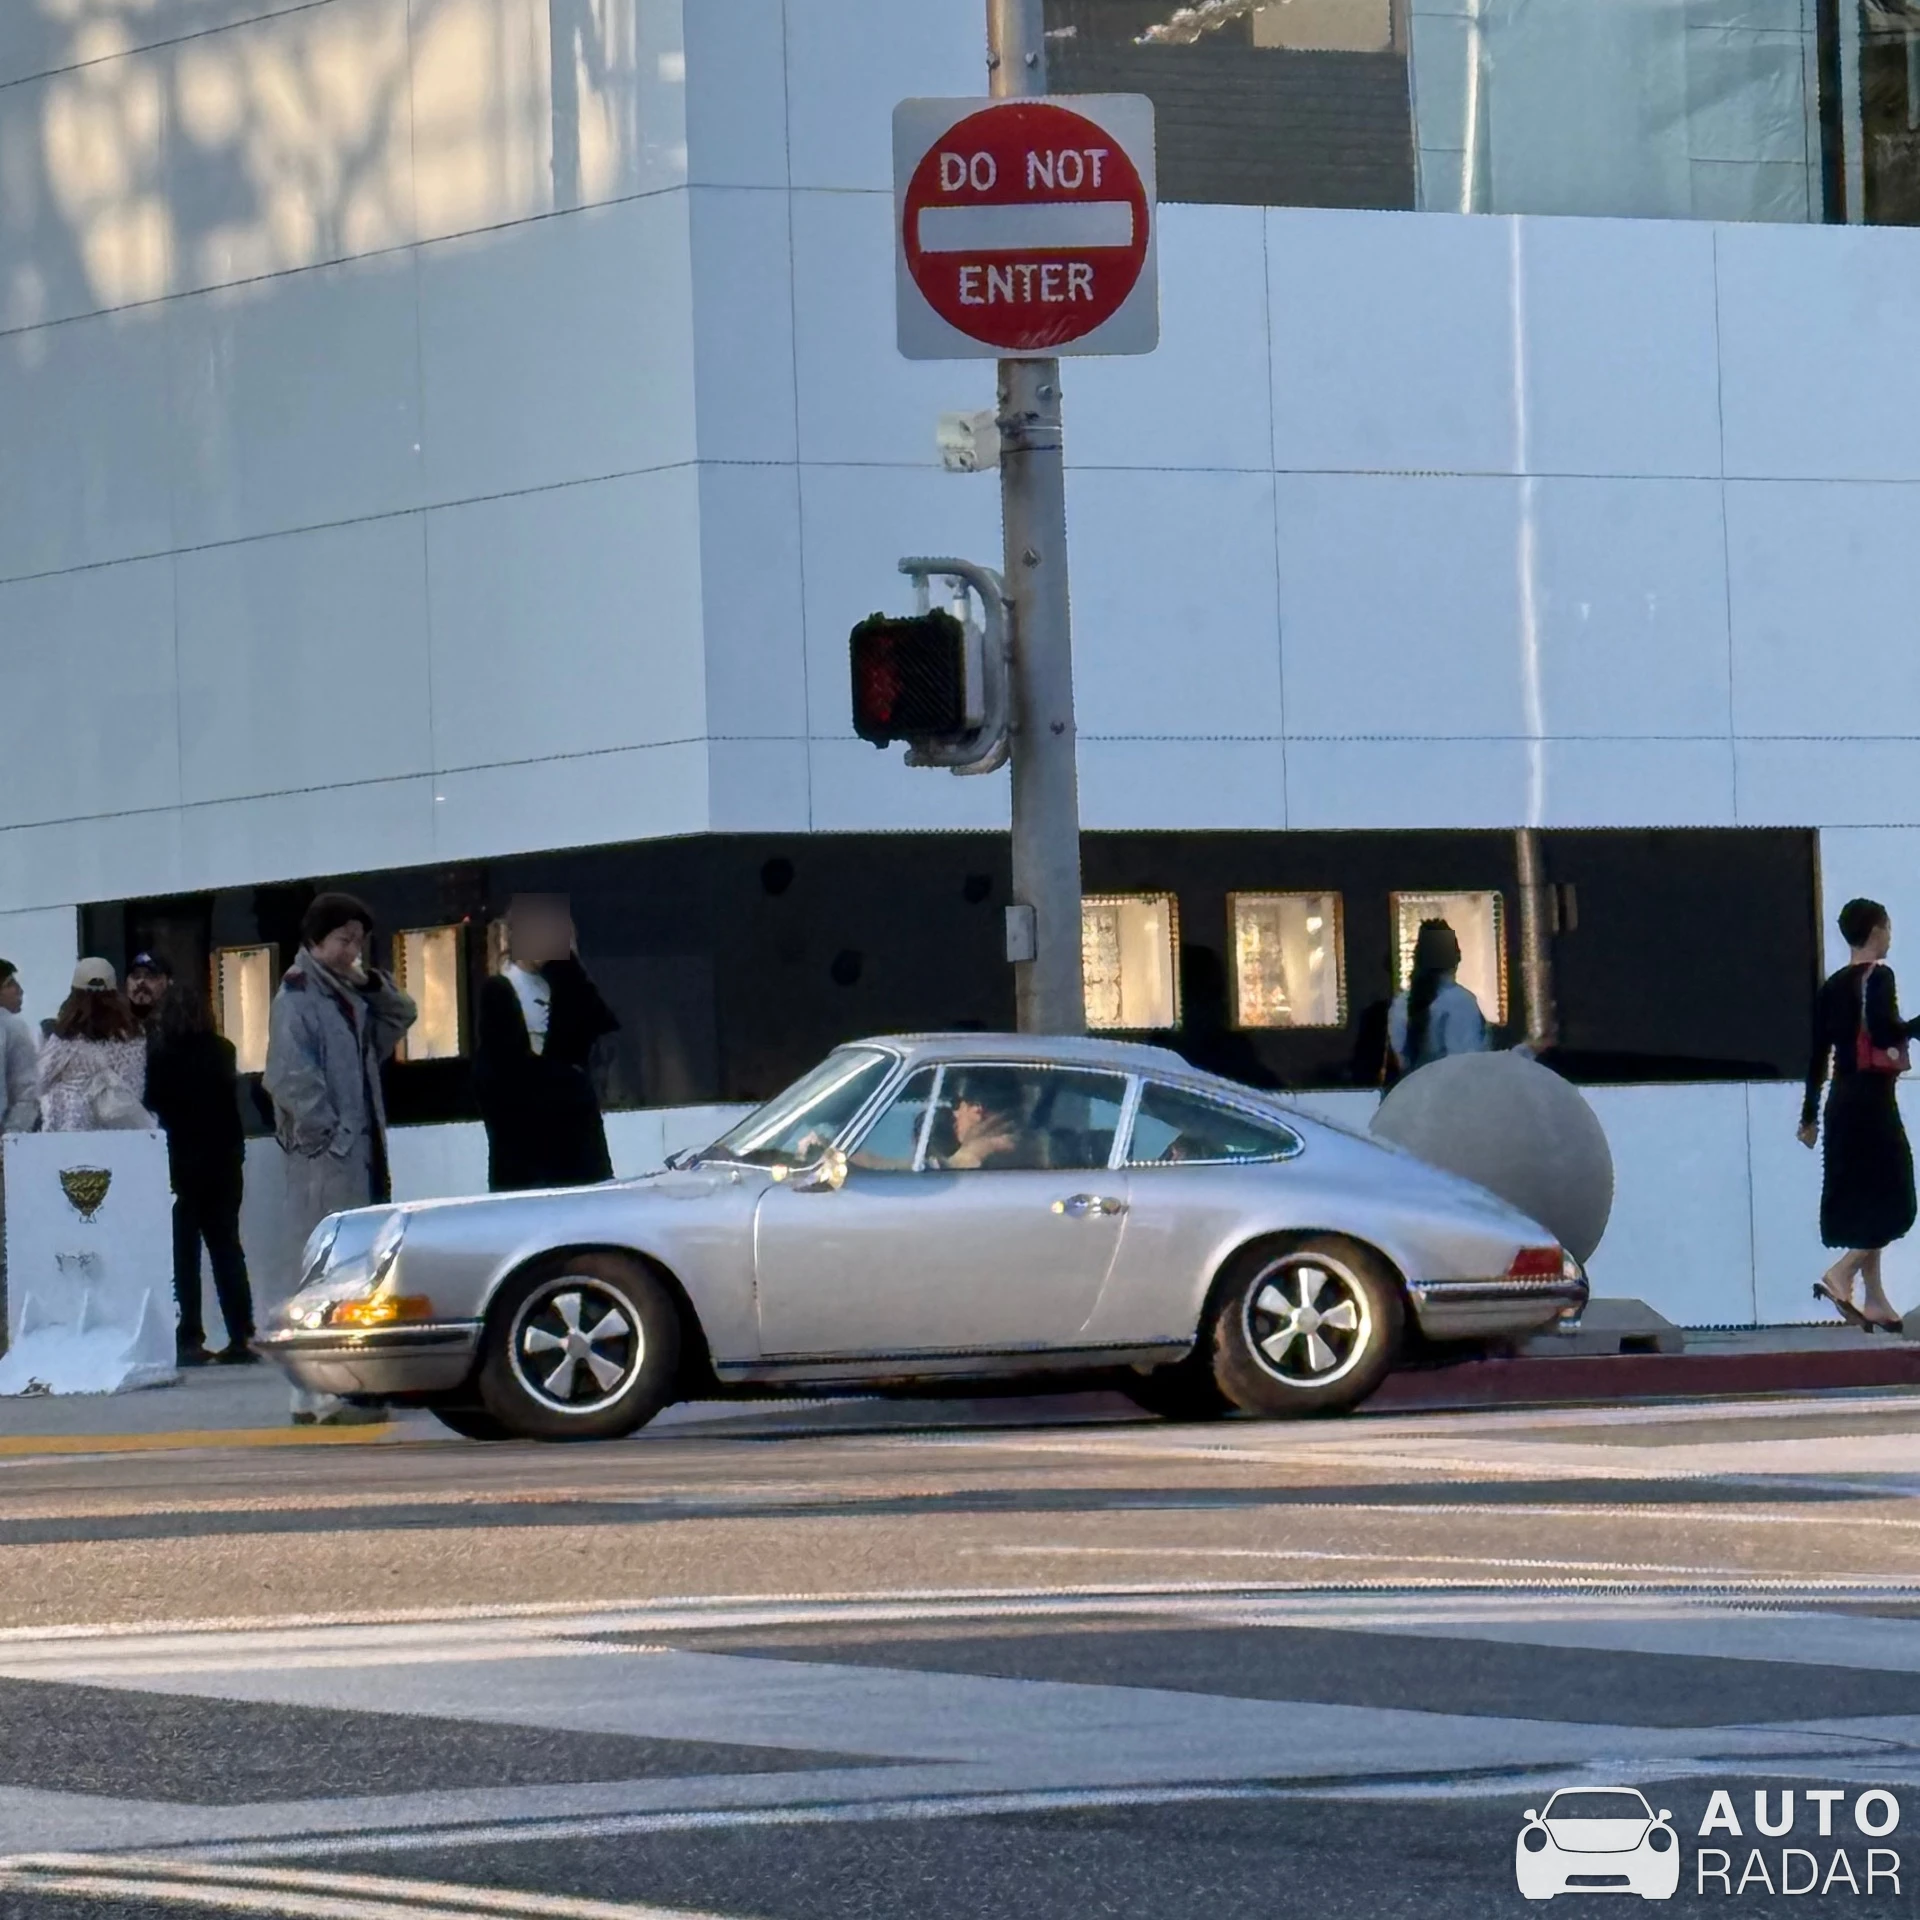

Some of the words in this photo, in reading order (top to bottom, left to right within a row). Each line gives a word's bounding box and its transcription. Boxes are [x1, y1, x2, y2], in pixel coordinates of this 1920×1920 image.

[940, 151, 997, 192] DO
[1026, 149, 1109, 190] NOT
[959, 262, 1094, 305] ENTER
